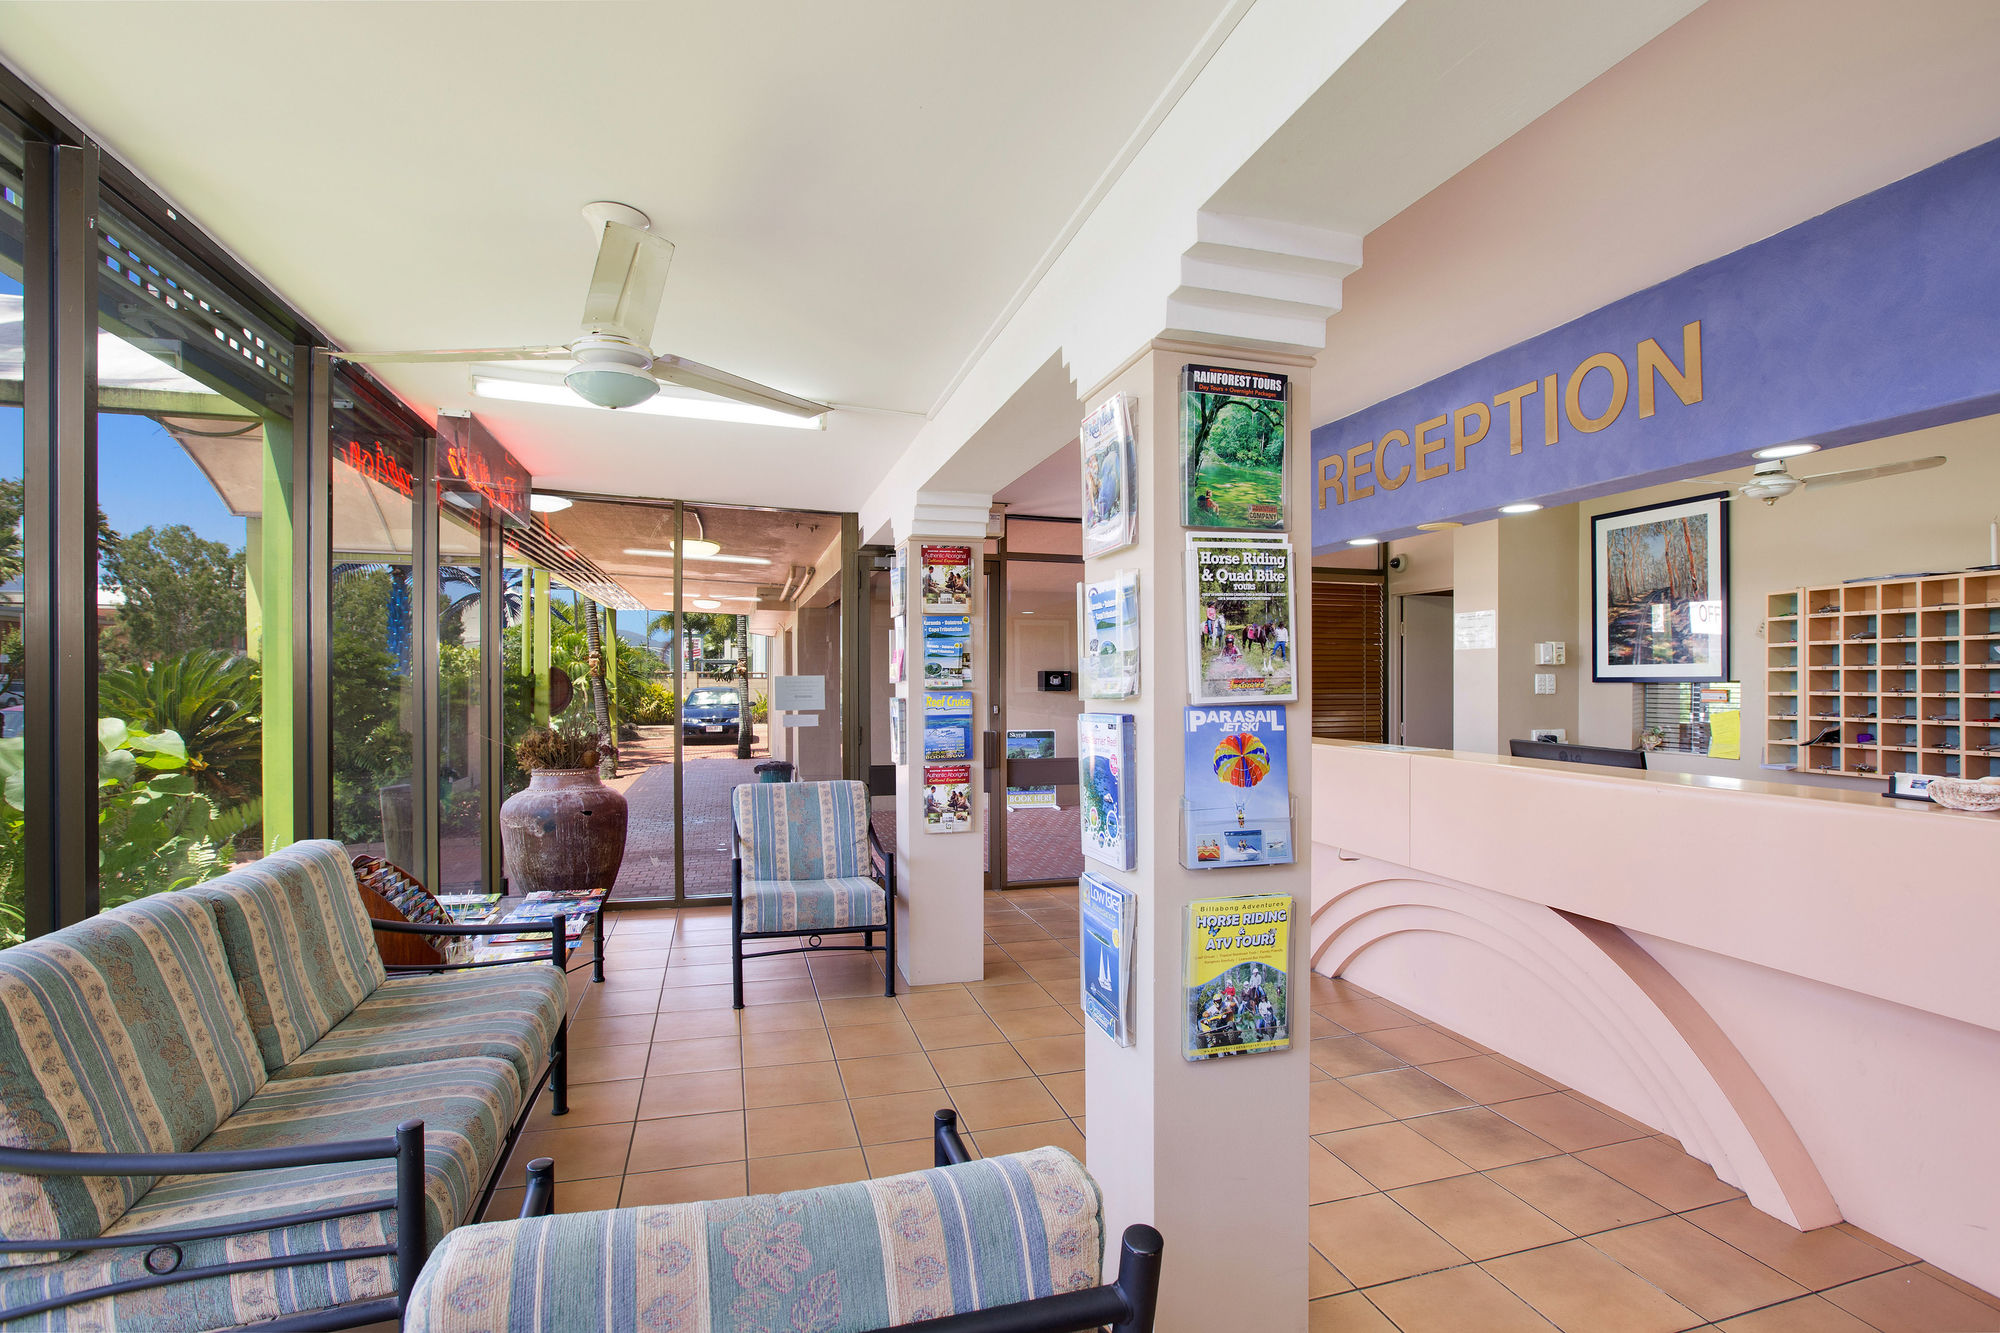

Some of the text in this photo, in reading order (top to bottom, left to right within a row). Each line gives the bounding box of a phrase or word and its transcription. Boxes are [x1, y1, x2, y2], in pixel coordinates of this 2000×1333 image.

[1194, 370, 1251, 388] RAINFOREST
[1253, 377, 1282, 392] TOURS
[1198, 384, 1209, 392] Day
[1229, 386, 1254, 395] Overnight
[1254, 388, 1277, 398] Packages
[1318, 319, 1703, 510] RECEPTION
[1200, 551, 1286, 568] Horse Riding
[1201, 568, 1286, 585] & Quad Bike
[1233, 583, 1256, 591] TOURS
[926, 696, 971, 707] Reef Cruise
[1189, 710, 1284, 733] PARASAIL
[1220, 722, 1259, 732] JET SKI
[1034, 794, 1053, 802] HERE
[1200, 902, 1284, 912] Billabong Adventures
[1196, 910, 1287, 929] HORSE RIDING
[1238, 927, 1245, 935] &
[1205, 932, 1276, 951] ATV TOURS
